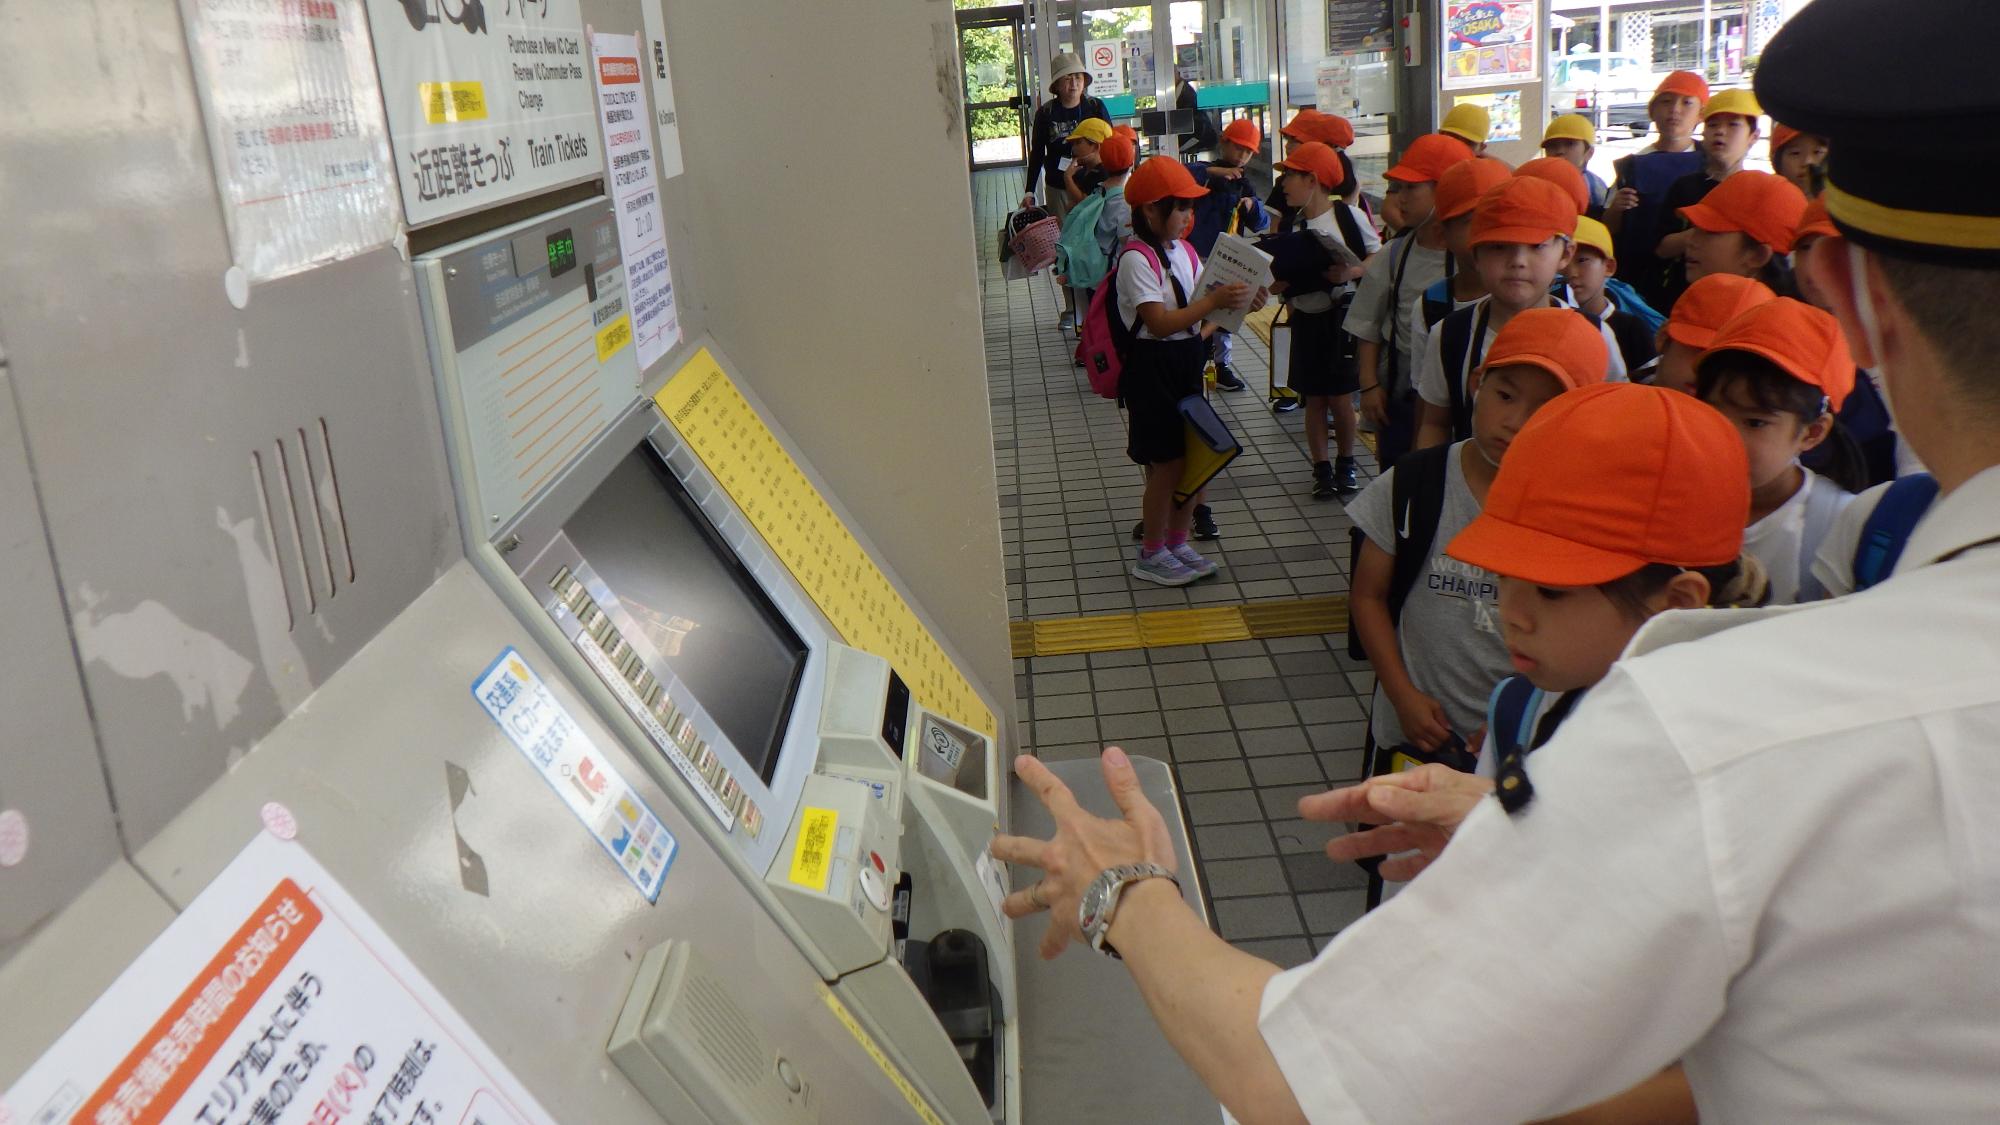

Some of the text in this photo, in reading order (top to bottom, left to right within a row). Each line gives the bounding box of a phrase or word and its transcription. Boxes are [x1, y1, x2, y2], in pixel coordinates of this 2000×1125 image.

[508, 34, 579, 54] Purchase a New IC Card
[1463, 17, 1501, 36] OSAKA
[512, 62, 534, 80] Renew
[534, 63, 542, 80] IC
[541, 63, 568, 80] Commuter
[568, 62, 582, 79] Pass
[518, 90, 543, 112] Charge
[410, 136, 515, 202] 近距離きっぷ
[527, 138, 556, 169] Train
[555, 133, 588, 162] Tickets
[486, 672, 523, 716] 交通系
[507, 684, 552, 741] ICカード
[238, 1041, 328, 1125] 業のため、
[305, 1043, 376, 1125] 日(火)の
